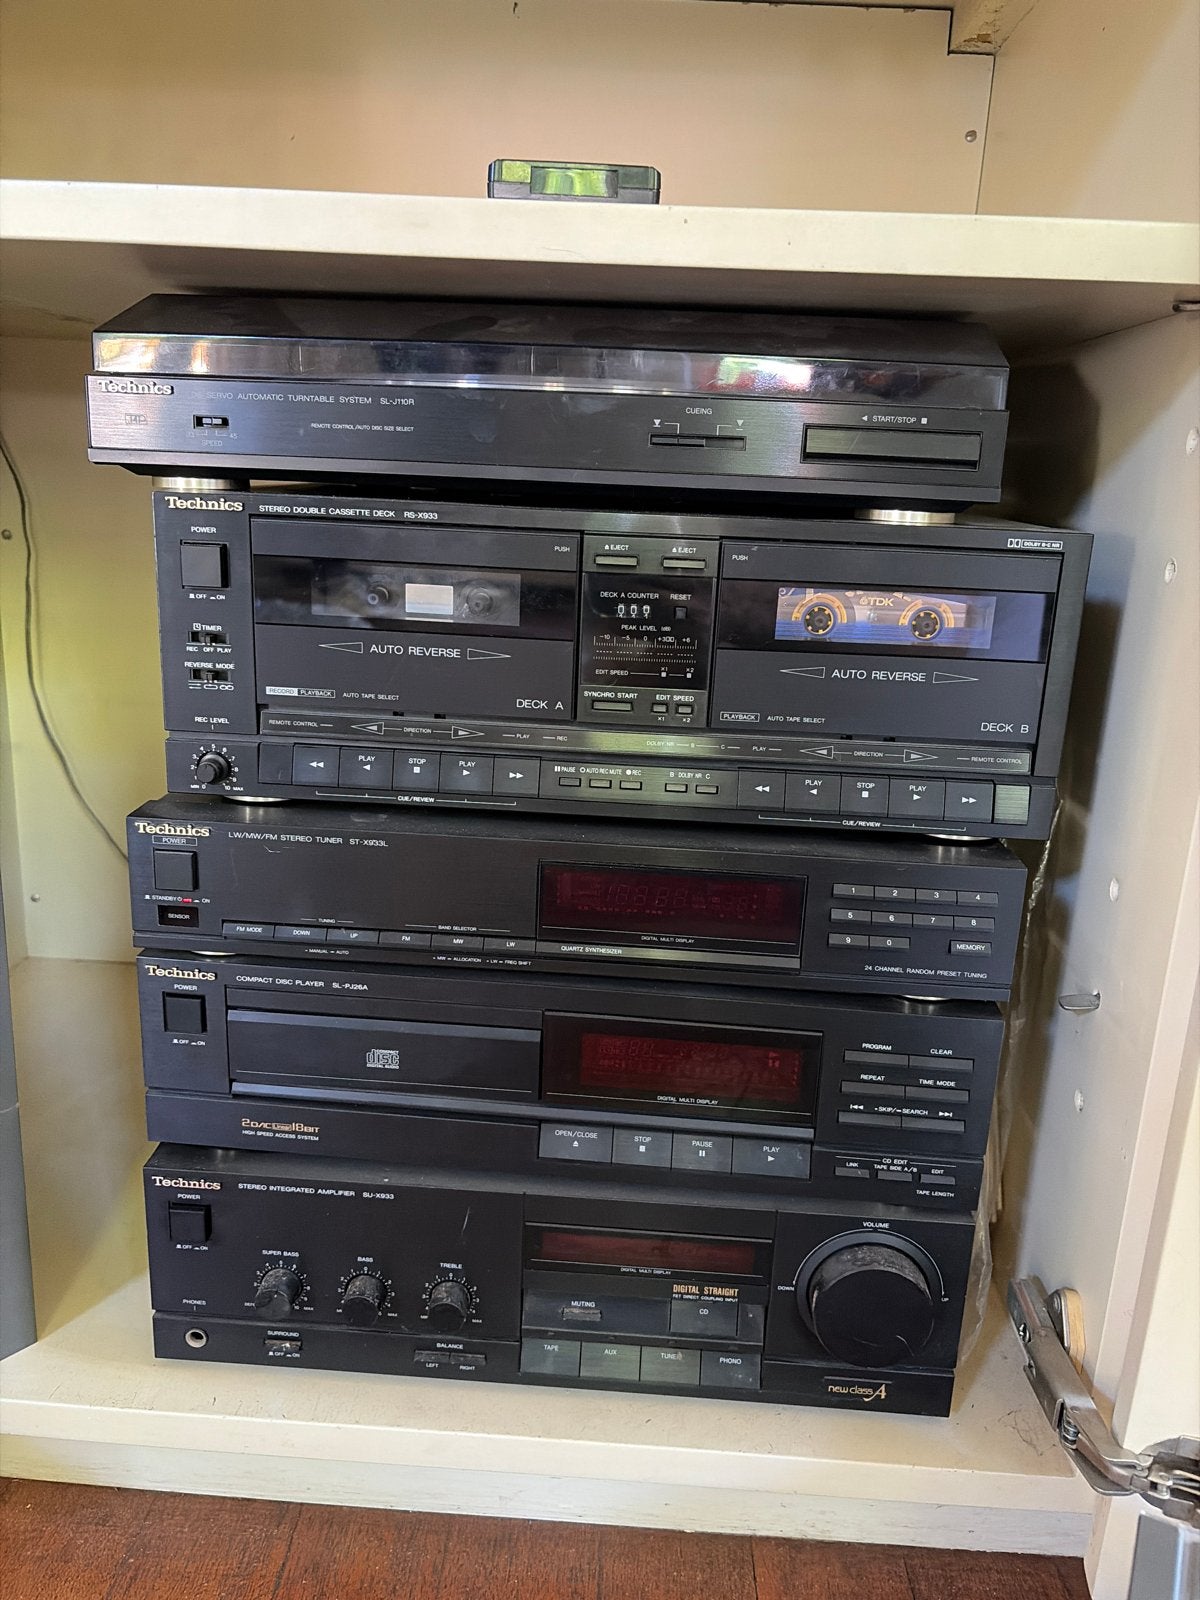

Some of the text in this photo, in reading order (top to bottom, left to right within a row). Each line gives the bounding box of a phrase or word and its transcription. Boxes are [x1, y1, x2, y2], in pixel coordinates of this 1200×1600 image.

[97, 380, 174, 395] Technics
[207, 392, 233, 400] SERVO
[237, 393, 284, 401] AUTOMATIC
[288, 395, 335, 403] TURNTABLE
[339, 396, 372, 404] SYSTEM
[380, 397, 415, 405] SL-J110R
[686, 407, 713, 415] CUEING
[872, 415, 917, 424] START/STOP
[165, 496, 244, 512] Technics
[259, 505, 438, 520] STEREO DOUBLE CASSETTE DECK RS-X933
[191, 526, 217, 534] POWER
[868, 596, 894, 607] TDK
[370, 644, 461, 658] AUTO REVERSE
[832, 669, 927, 682] AUTO REVERSE
[516, 699, 564, 710] DECK A
[981, 722, 1029, 733] DECK B
[134, 821, 210, 837] Technics
[228, 831, 389, 847] LW/MW/FM STEREO TUNER ST-X933L
[561, 945, 622, 955] QUARTZ SYNTHESIZER
[956, 943, 986, 951] MEMORY
[144, 965, 217, 981] Technics
[874, 965, 904, 973] CHANNEL
[236, 975, 325, 987] COMPACT DISC PLAYER
[930, 1048, 953, 1056] CLEAR
[919, 1078, 934, 1086] TIME
[555, 1129, 598, 1139] OPEN/CLOSE
[634, 1135, 652, 1143] STOP
[692, 1140, 713, 1148] PAUSE
[763, 1145, 780, 1153] PLAY
[152, 1175, 221, 1191] Technics
[238, 1183, 395, 1200] STEREO INTEGRATED AMPLIFIER SU-X933
[863, 1221, 890, 1229] VOLUME
[440, 1262, 462, 1270] TREBLE
[673, 1284, 739, 1296] DIGITAL STRAIGHT
[699, 1308, 709, 1316] CD
[437, 1342, 464, 1350] BALANCE
[544, 1344, 559, 1352] TAPE
[719, 1357, 742, 1365] PHONO
[828, 1383, 887, 1402] new class A
